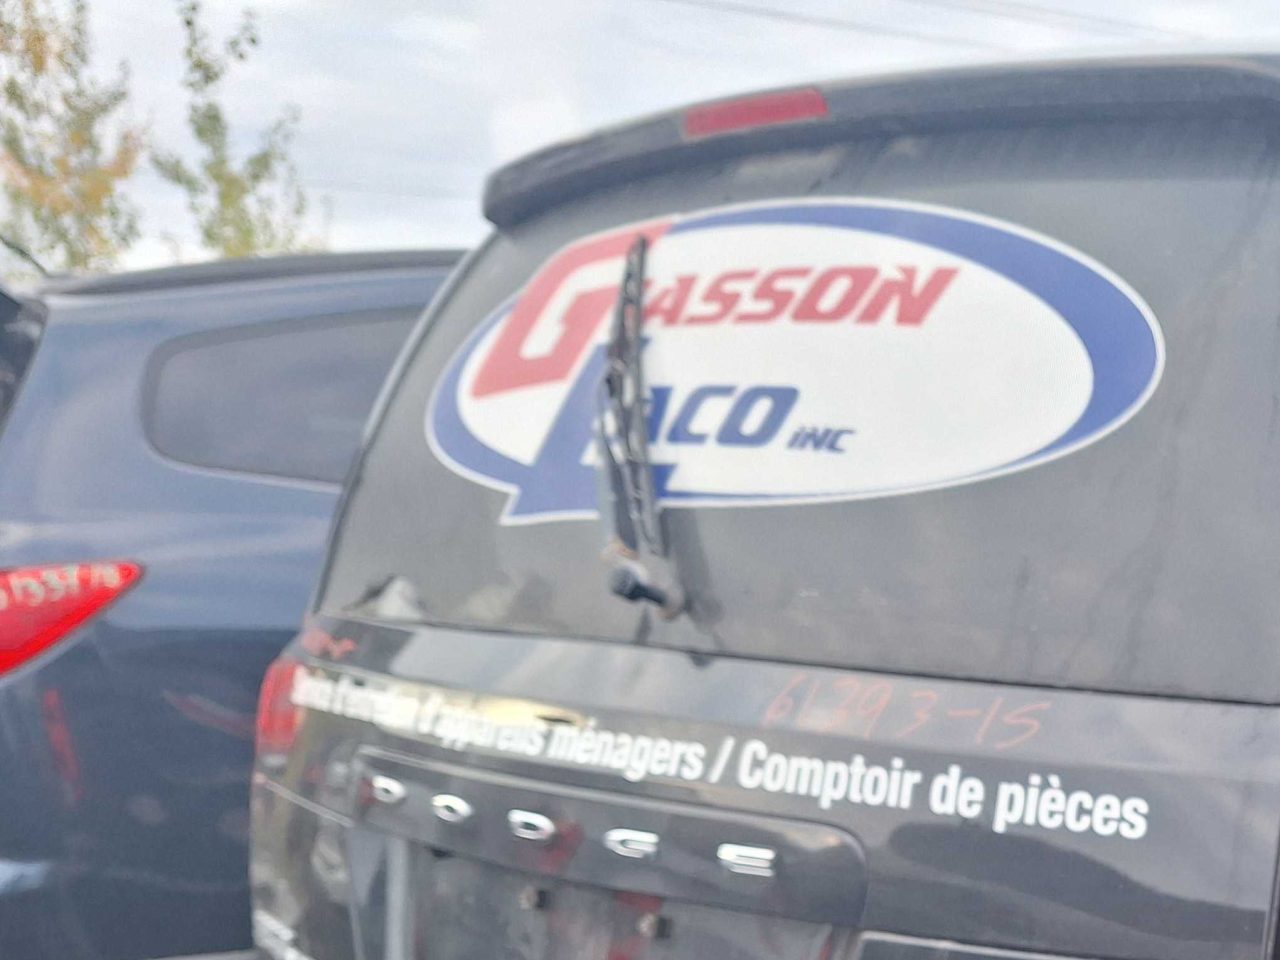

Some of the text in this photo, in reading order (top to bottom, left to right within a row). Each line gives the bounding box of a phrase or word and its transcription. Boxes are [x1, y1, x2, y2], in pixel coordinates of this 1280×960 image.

[371, 773, 778, 878] DODGE
[546, 717, 706, 783] ménagers
[737, 738, 921, 810] Comptoir
[929, 764, 985, 819] de
[992, 773, 1150, 840] pièces
